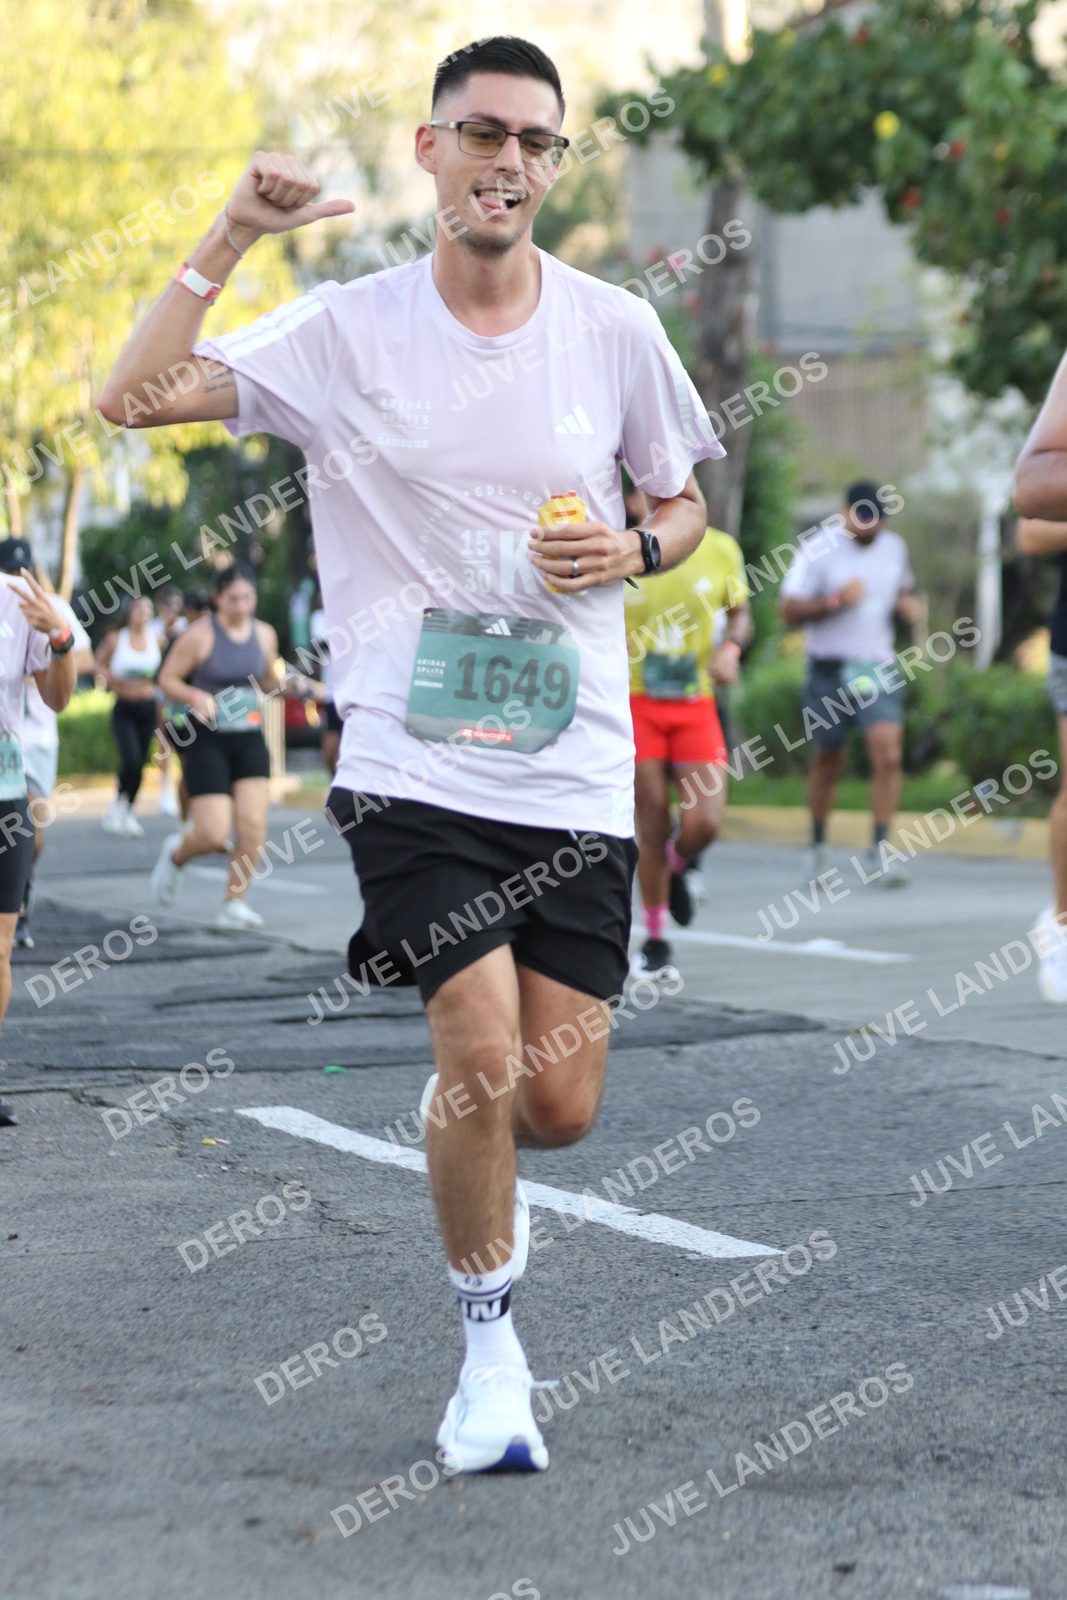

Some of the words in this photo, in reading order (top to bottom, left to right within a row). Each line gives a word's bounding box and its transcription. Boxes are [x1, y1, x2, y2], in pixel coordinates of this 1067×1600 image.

[460, 529, 491, 557] 15
[463, 567, 492, 594] 30
[454, 652, 571, 711] 1649
